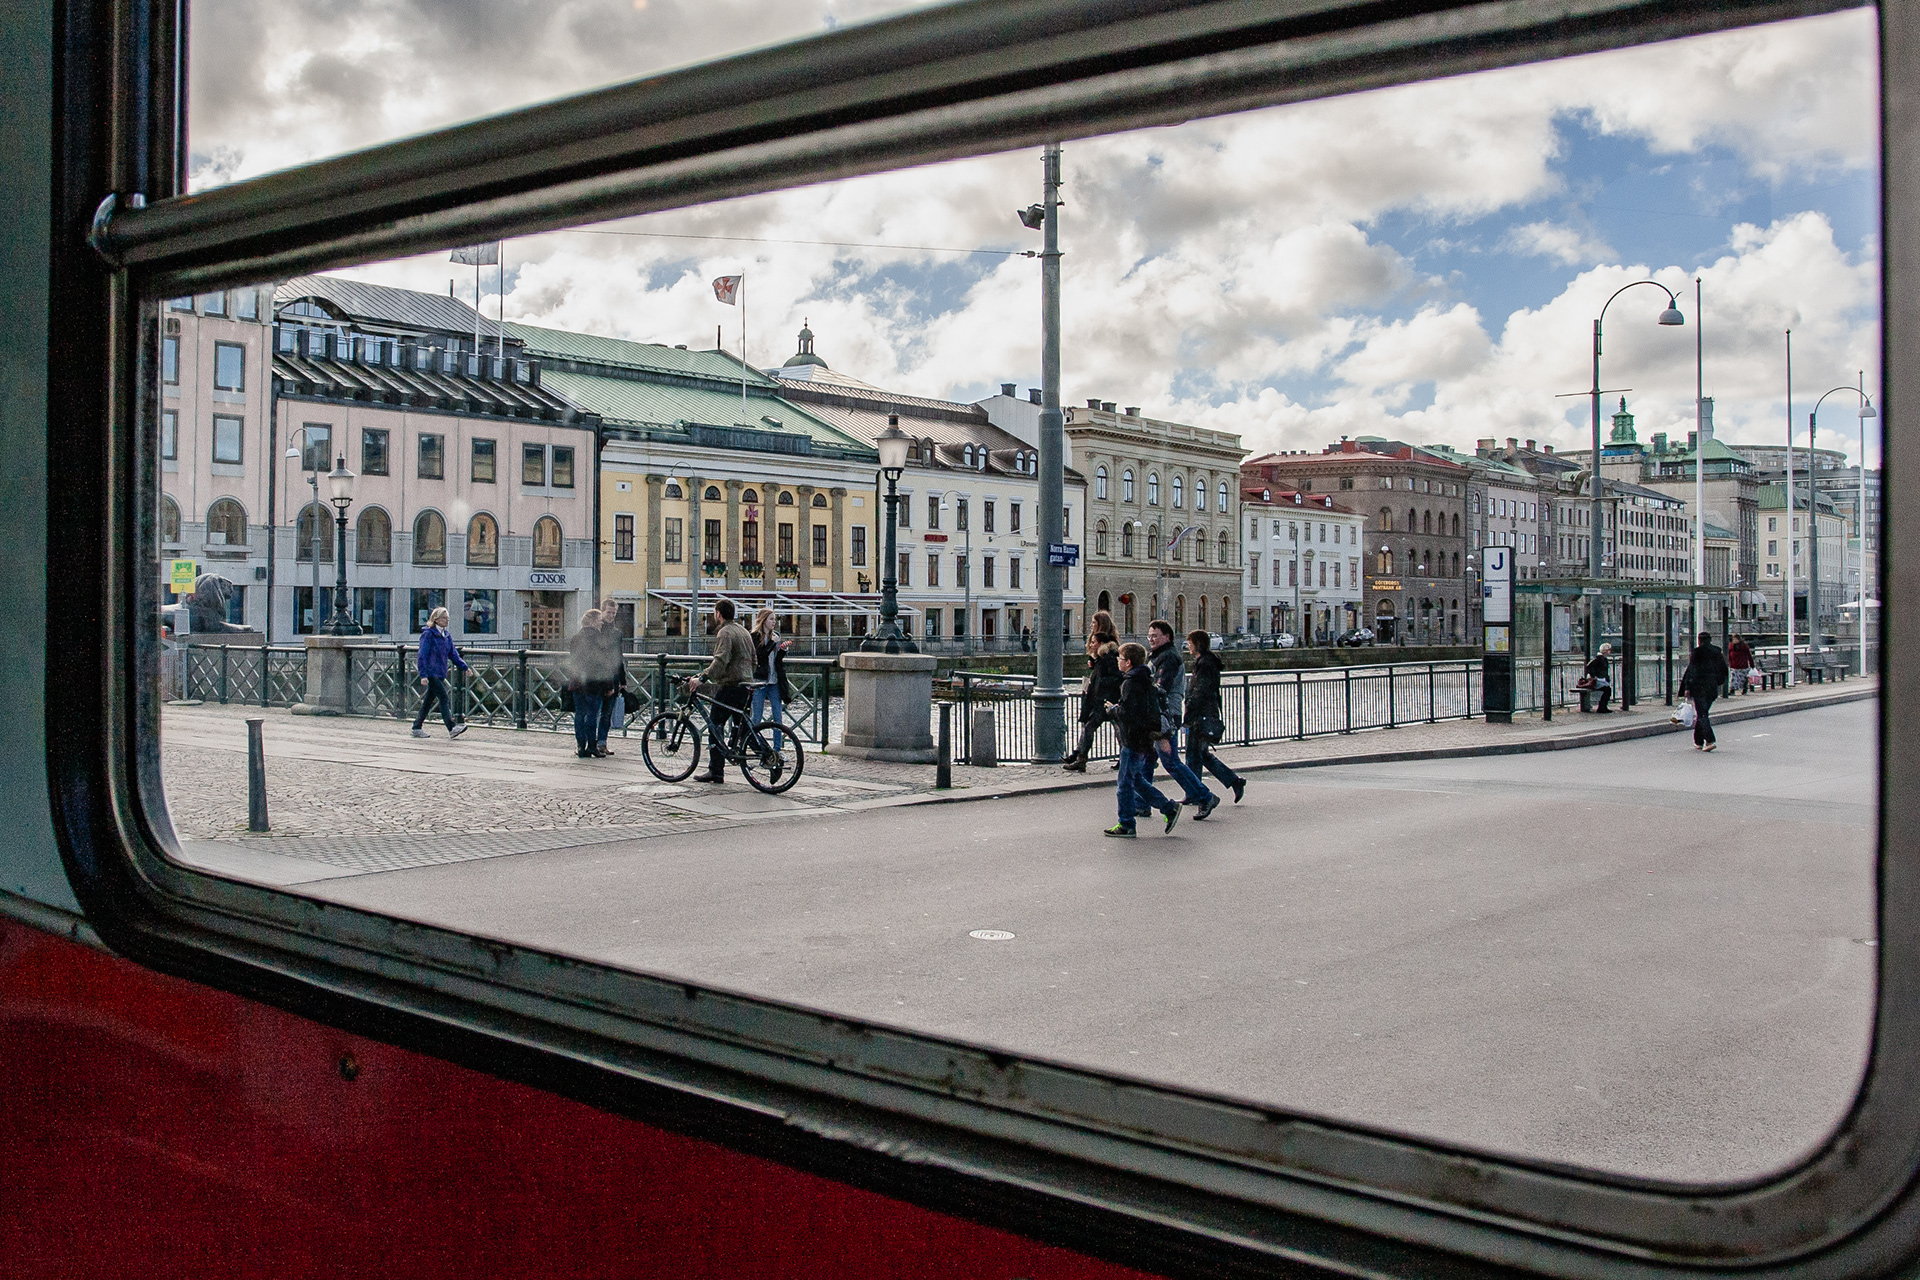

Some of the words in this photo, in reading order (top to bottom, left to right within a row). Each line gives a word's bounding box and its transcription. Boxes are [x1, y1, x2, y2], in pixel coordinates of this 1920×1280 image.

[1050, 545, 1062, 553] Norra
[1491, 552, 1504, 571] J
[531, 574, 566, 583] CENSOR
